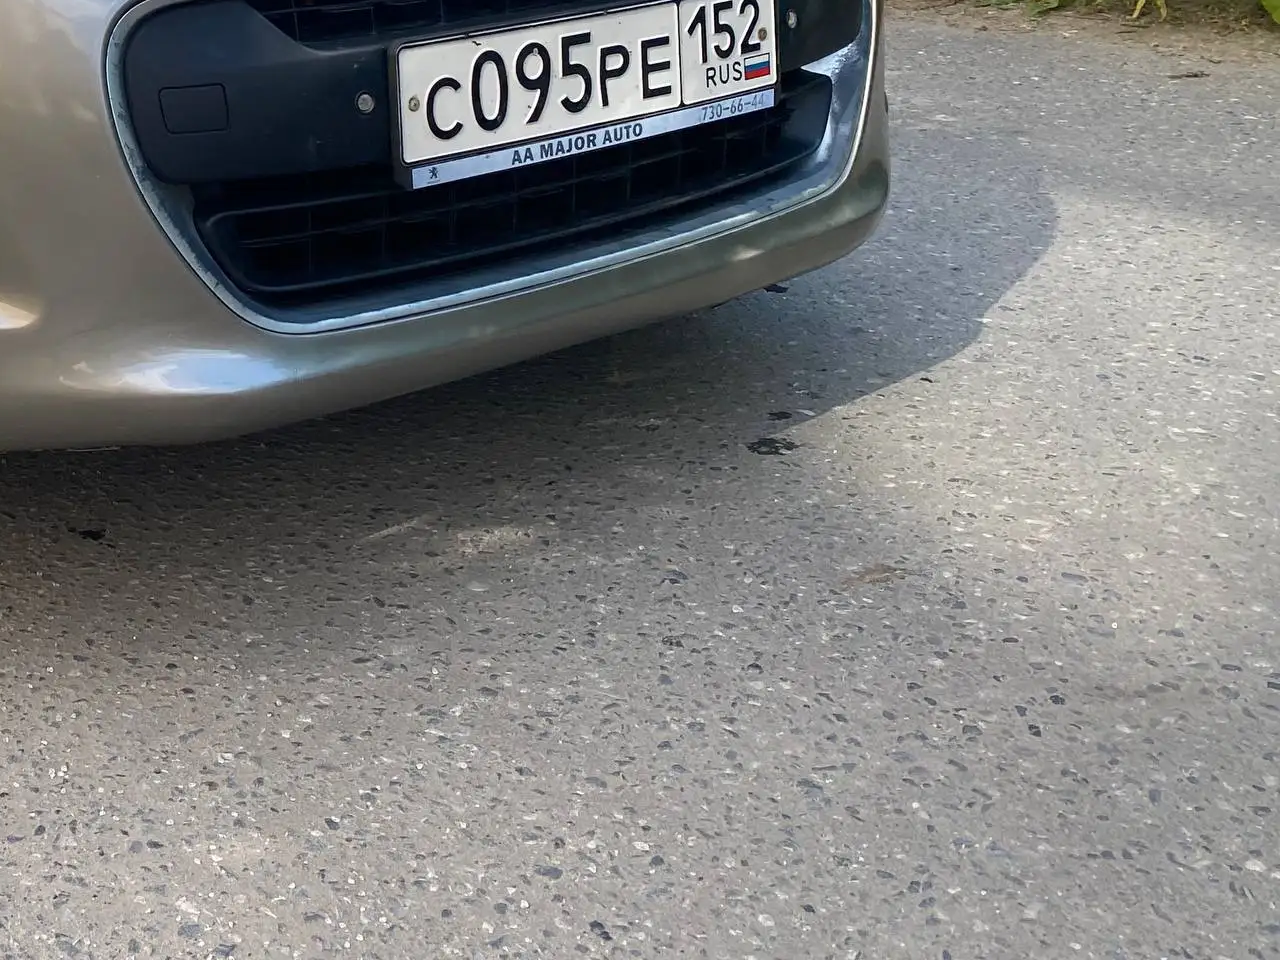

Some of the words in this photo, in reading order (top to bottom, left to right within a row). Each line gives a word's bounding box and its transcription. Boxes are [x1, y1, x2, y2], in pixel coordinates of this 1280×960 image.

[705, 61, 743, 88] RUS
[701, 93, 765, 121] 730-66-44
[511, 147, 534, 166] AA
[539, 132, 597, 159] MAJOR
[599, 123, 643, 147] AUTO
